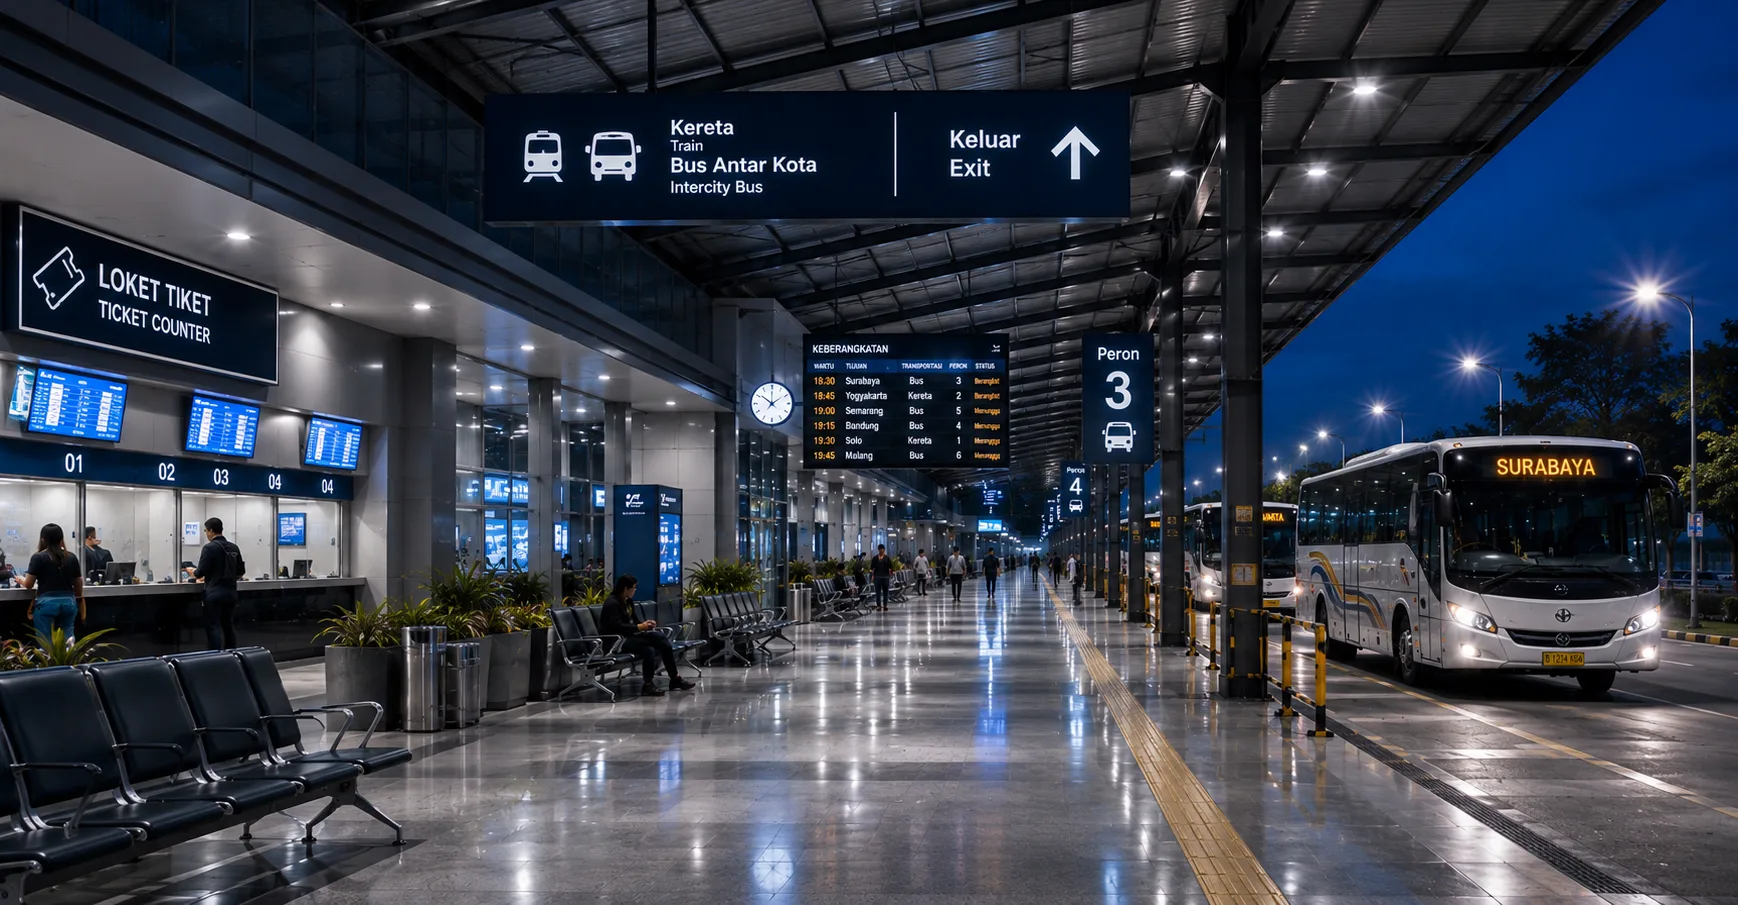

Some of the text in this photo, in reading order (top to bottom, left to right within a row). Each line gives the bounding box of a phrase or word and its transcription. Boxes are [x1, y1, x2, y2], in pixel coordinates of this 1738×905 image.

[670, 119, 734, 136] Kereta
[669, 139, 704, 152] Train
[950, 129, 1021, 149] Keluar
[670, 156, 817, 174] Bus Antar Kota
[950, 157, 991, 177] Exit
[670, 179, 764, 197] Intercity Bus
[98, 263, 212, 317] LOKET TIKET
[98, 299, 211, 345] TICKET COUNTER
[812, 344, 889, 354] KEBERANGKATAN
[1097, 346, 1140, 361] Peron
[846, 376, 880, 386] Surabaya
[910, 376, 924, 384] Bus
[955, 376, 962, 385] 3
[1104, 370, 1132, 410] 3
[846, 392, 888, 402] Yogyakarta
[908, 392, 932, 400] Kereta
[956, 391, 962, 400] 2
[846, 406, 884, 416] Semarang
[910, 406, 924, 414] Bus
[955, 406, 962, 415] 5
[814, 422, 836, 430] 19:15
[846, 422, 878, 432] Bandung
[910, 422, 924, 430] Bus
[955, 421, 962, 430] 4
[846, 436, 862, 444] Solo
[908, 436, 932, 444] Kereta
[64, 452, 82, 474] 01
[814, 452, 836, 460] 19:45
[910, 450, 924, 460] Bus
[955, 450, 962, 460] 6
[158, 462, 176, 482] 02
[1496, 457, 1596, 477] SURABAYA
[214, 468, 228, 486] 03
[322, 478, 334, 494] 04
[1070, 477, 1083, 496] 4
